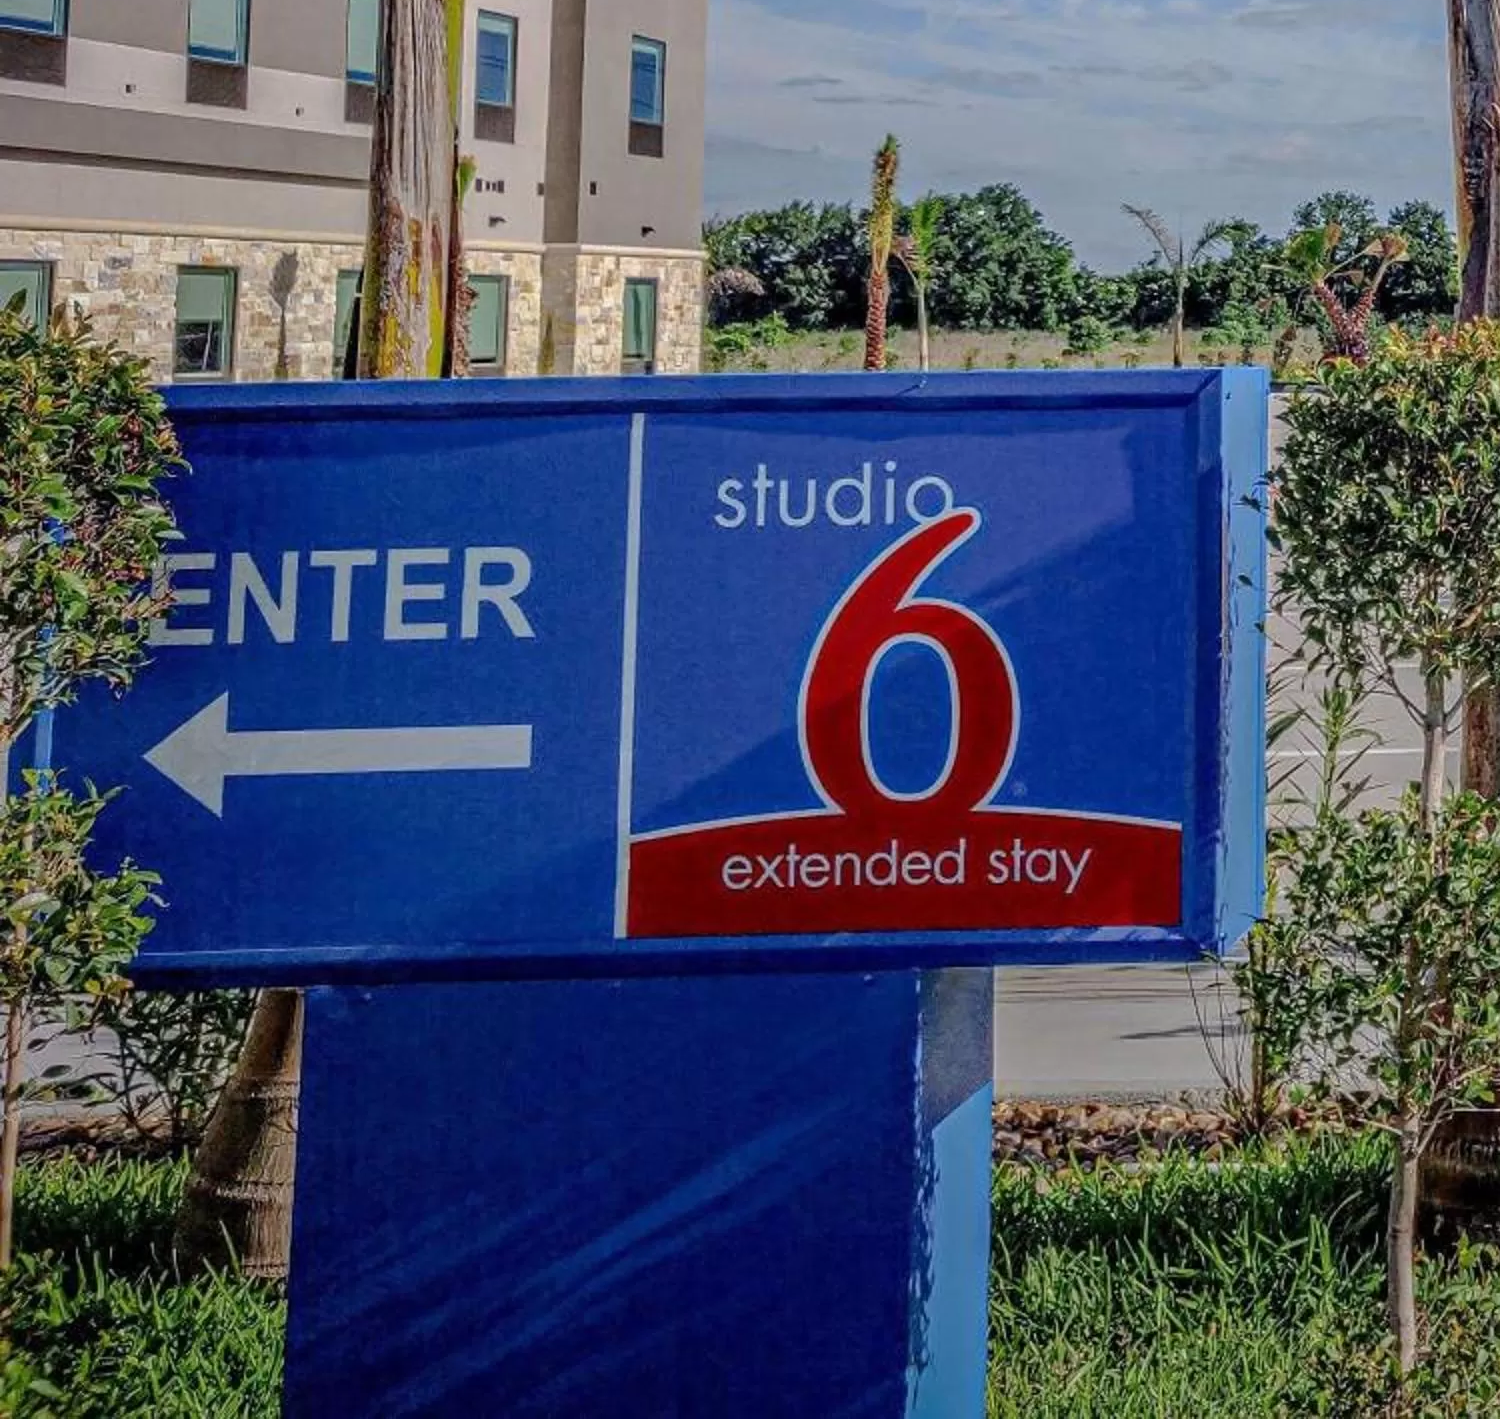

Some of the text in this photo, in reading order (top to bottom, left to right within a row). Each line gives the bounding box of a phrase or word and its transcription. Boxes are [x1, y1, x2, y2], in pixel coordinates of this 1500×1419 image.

[714, 461, 954, 528] studio
[146, 546, 536, 646] ENTER
[797, 507, 1021, 813] 6
[721, 838, 1093, 894] extended stay
